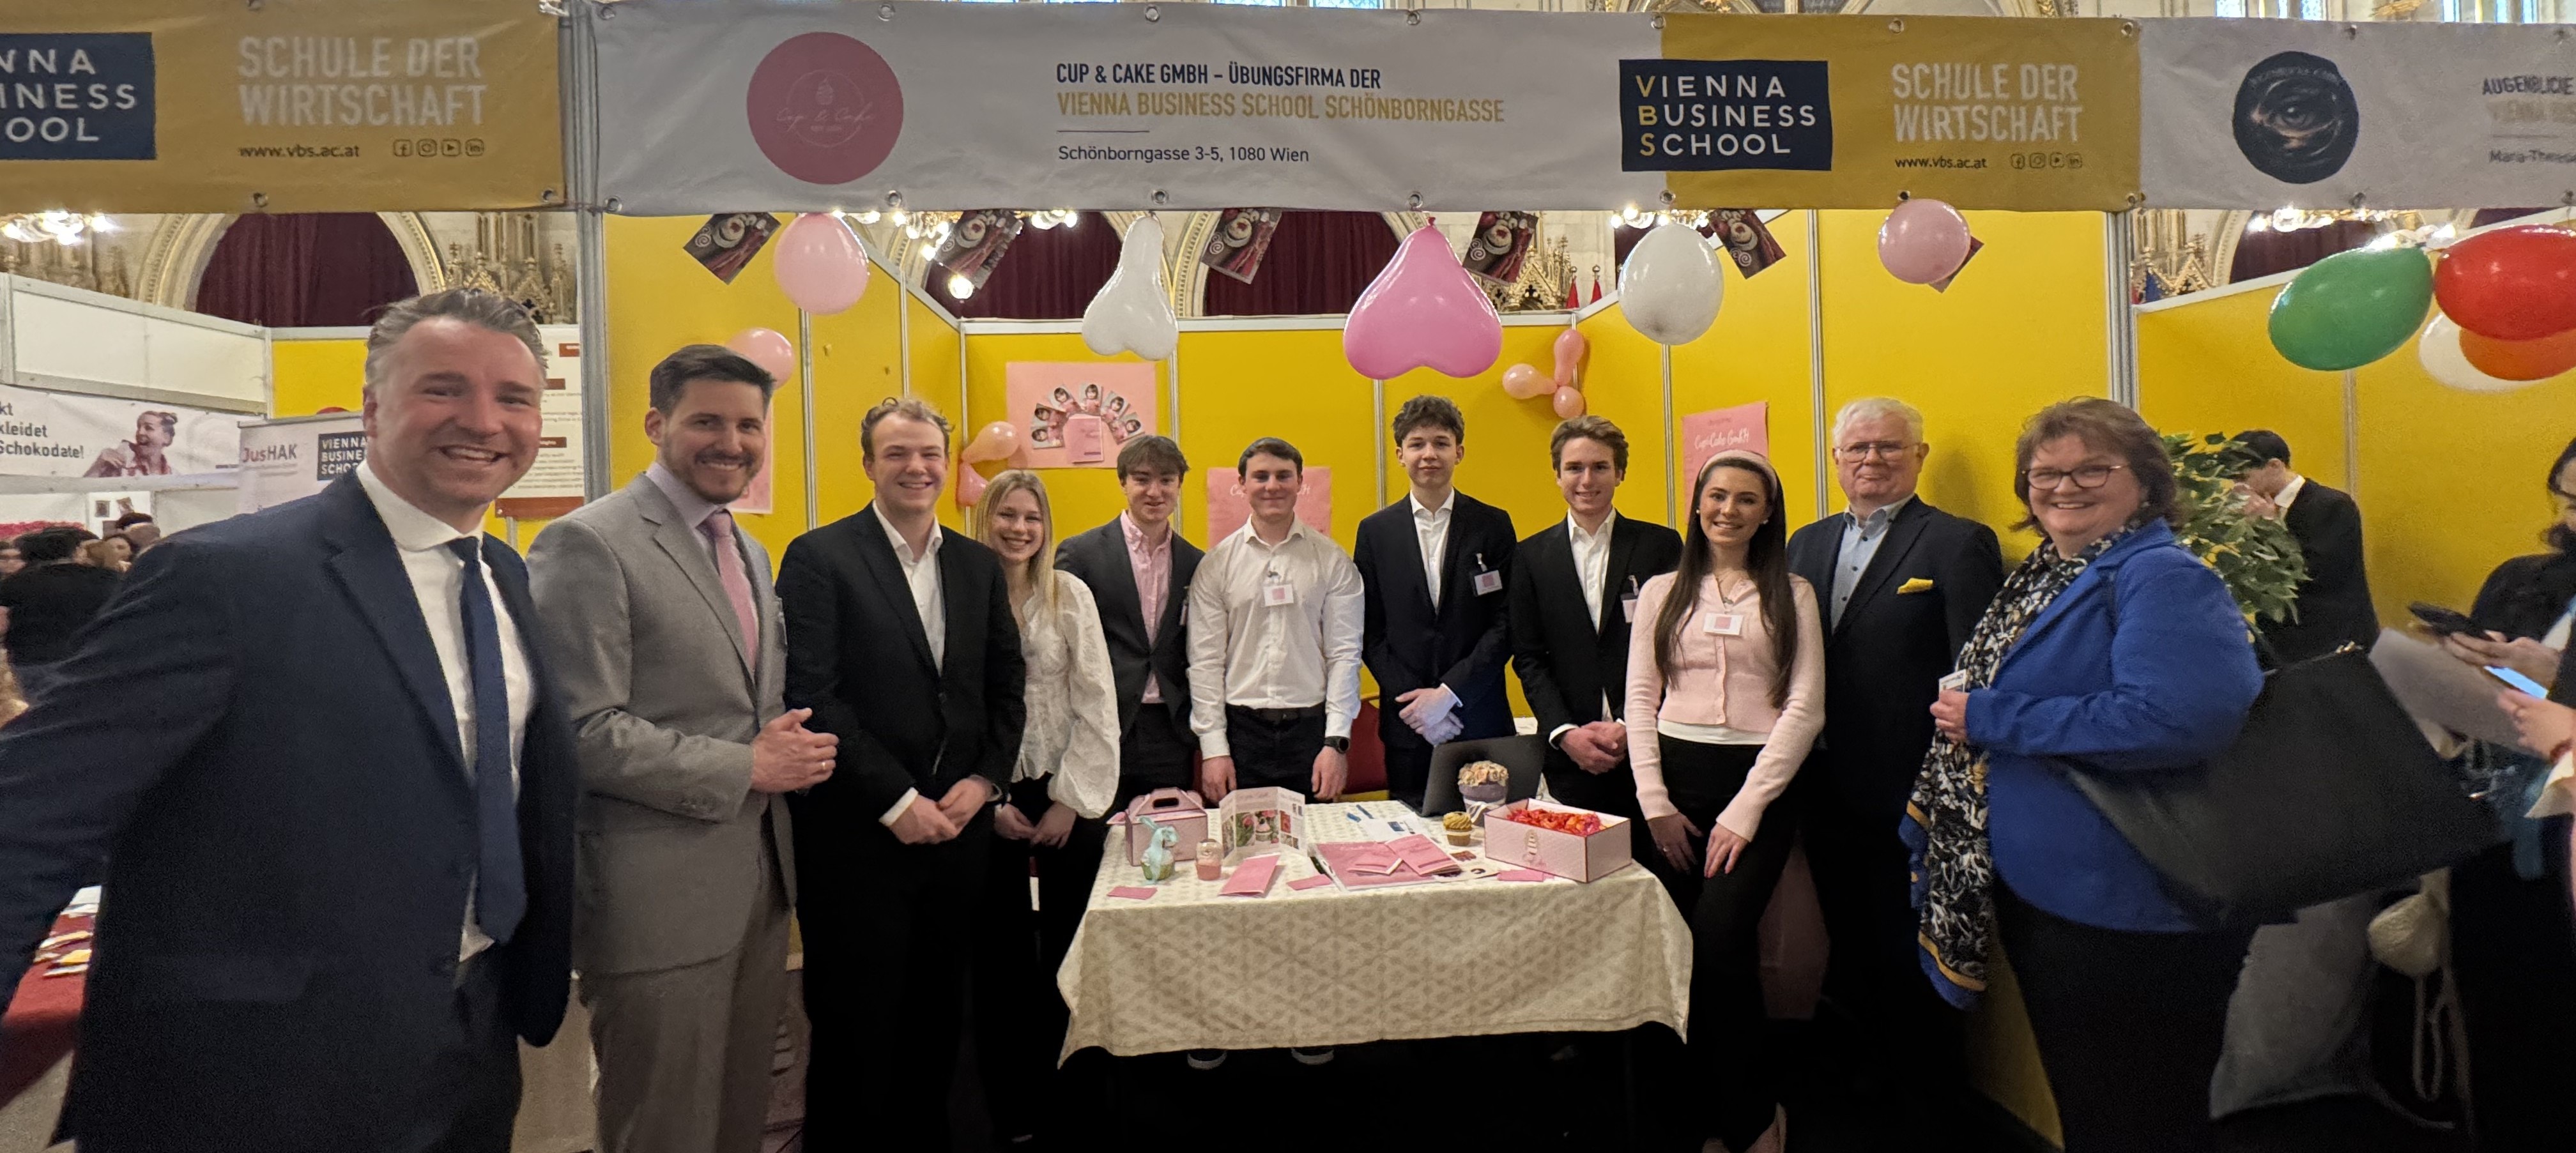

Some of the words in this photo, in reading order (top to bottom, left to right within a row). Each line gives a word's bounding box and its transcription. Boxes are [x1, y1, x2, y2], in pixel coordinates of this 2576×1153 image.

[238, 36, 392, 77] SCHULE
[406, 36, 481, 77] DER
[1057, 63, 1089, 83] CUP
[1094, 65, 1107, 83] &
[1112, 63, 1155, 83] CAKE
[1160, 64, 1208, 84] GMBH
[1229, 61, 1345, 88] ÜBUNGSFIRMA
[1350, 68, 1381, 89] DER
[1636, 74, 1786, 98] VIENNA
[1891, 63, 2010, 100] SCHULE
[2020, 63, 2079, 102] DER
[239, 84, 488, 126] WIRTSCHAFT
[1057, 92, 1131, 116] VIENNA
[1137, 92, 1236, 116] BUSINESS
[1242, 93, 1319, 119] SCHOOL
[1324, 92, 1505, 122] SCHÖNBORNGASSE
[1638, 103, 1816, 127] BUSINESS
[5, 116, 100, 142] OOL
[1894, 104, 2083, 142] WIRTSCHAFT
[238, 144, 360, 158] www.vbs.ac.at
[1058, 146, 1190, 163] Schönborngasse
[1195, 146, 1224, 162] 3-5,
[1229, 146, 1266, 161] 1080
[1270, 147, 1309, 162] Wien
[1639, 132, 1791, 156] SCHOOL
[1895, 156, 1988, 169] www.vbs.ac.at
[321, 450, 367, 462] BUSINE
